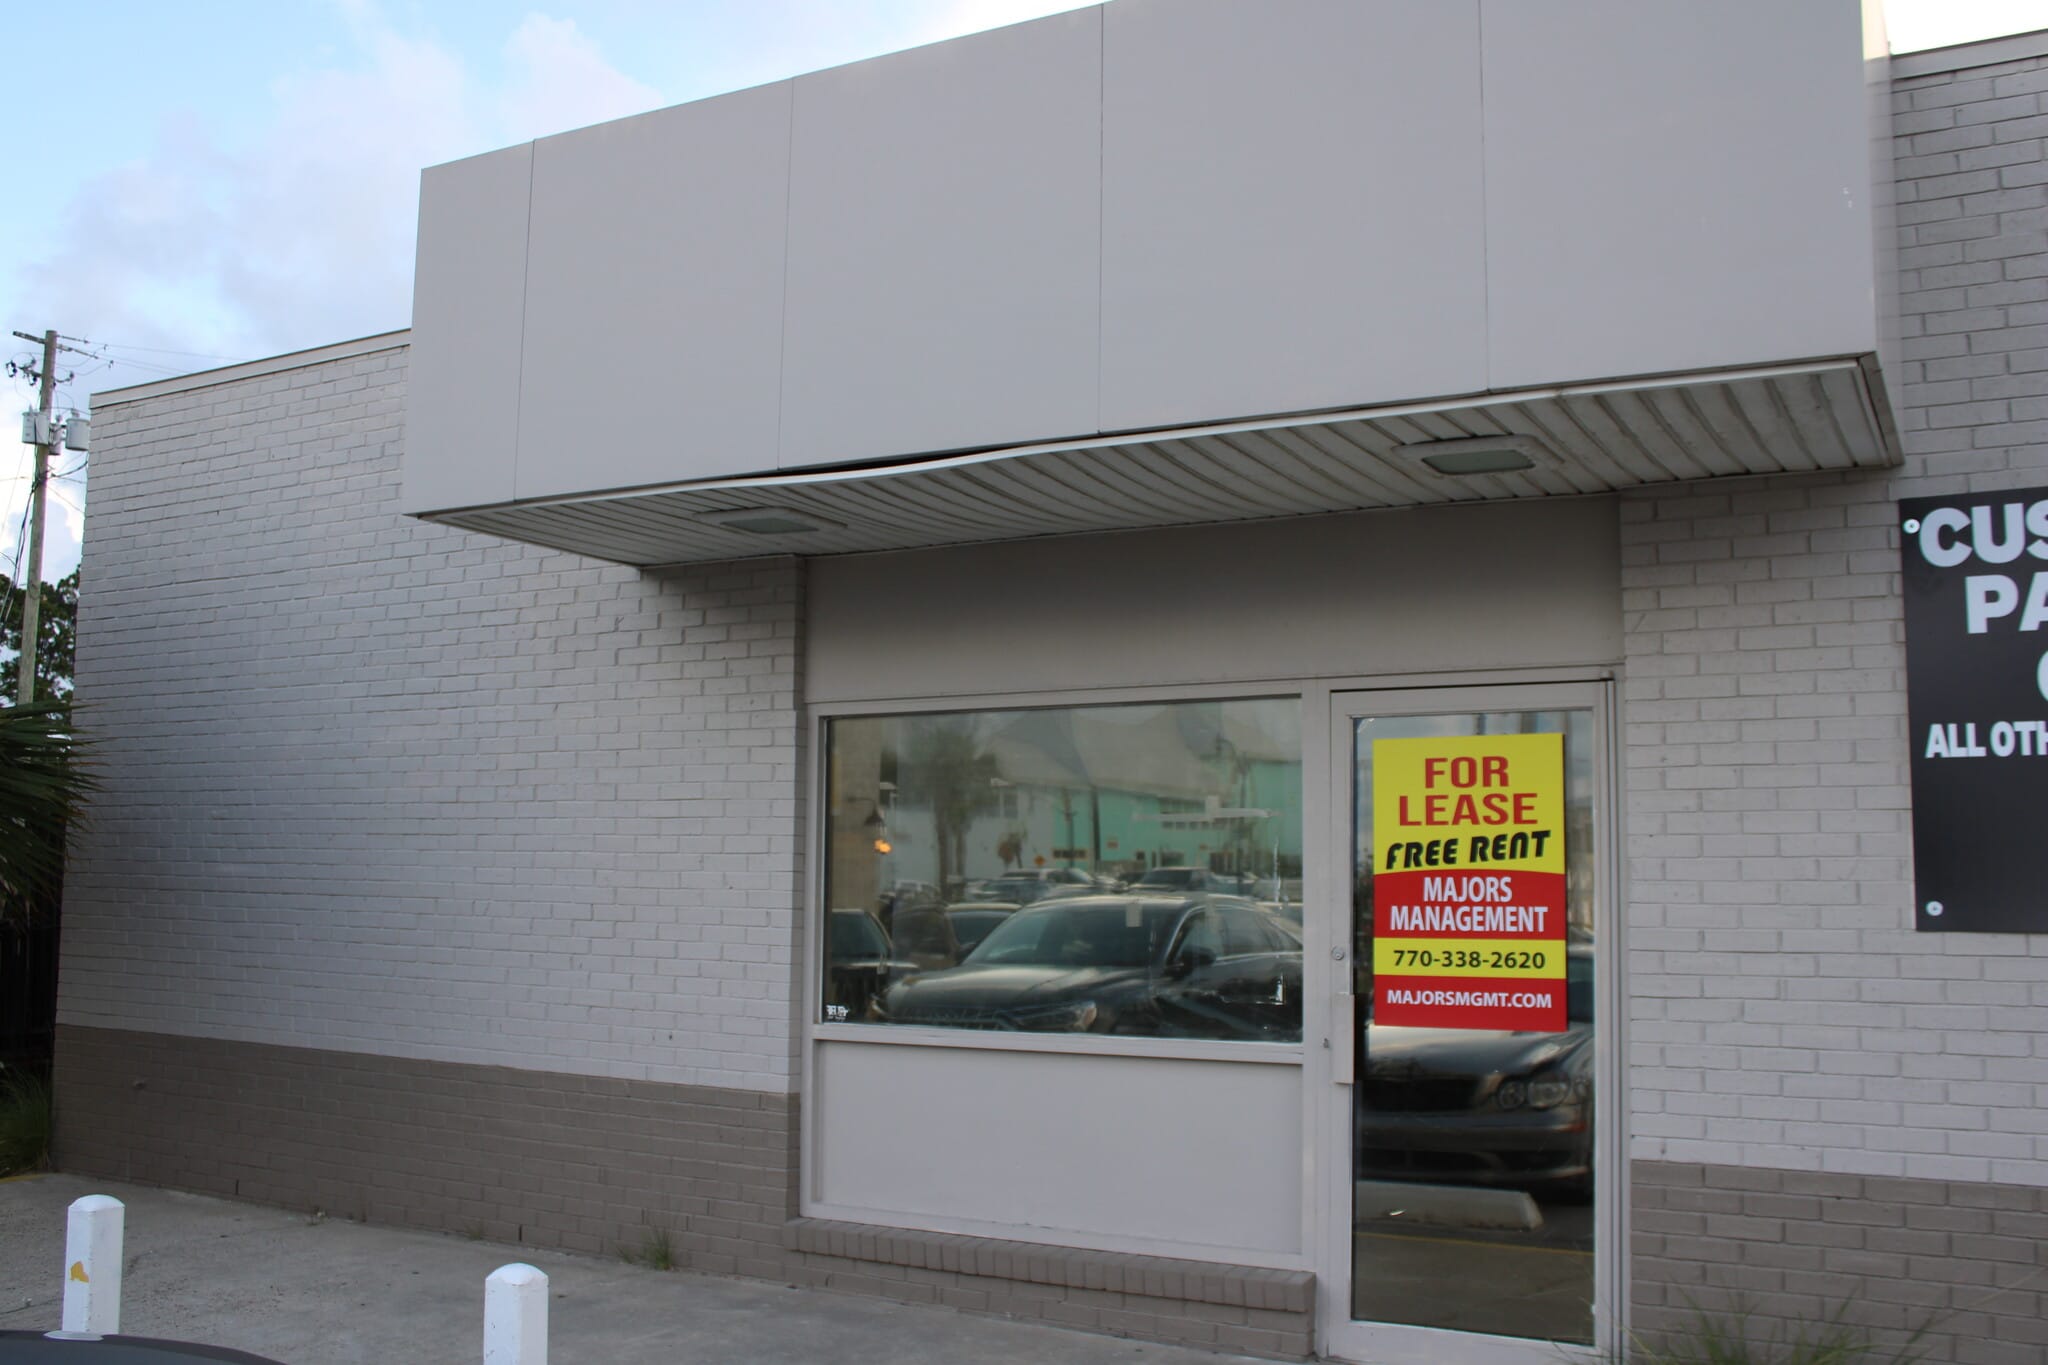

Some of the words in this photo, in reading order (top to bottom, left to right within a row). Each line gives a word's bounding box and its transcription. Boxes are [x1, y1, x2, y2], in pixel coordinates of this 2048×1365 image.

[1925, 723, 1987, 759] ALL
[1424, 756, 1509, 789] FOR
[1399, 793, 1538, 827] LEASE
[1386, 838, 1458, 870] FREE
[1469, 830, 1551, 863] RENT
[1423, 876, 1513, 903] MAJORS
[1390, 905, 1549, 933] MANAGEMENT
[1393, 949, 1546, 969] 770-338-2620
[1387, 989, 1552, 1009] MAJORSMGMT.COM
